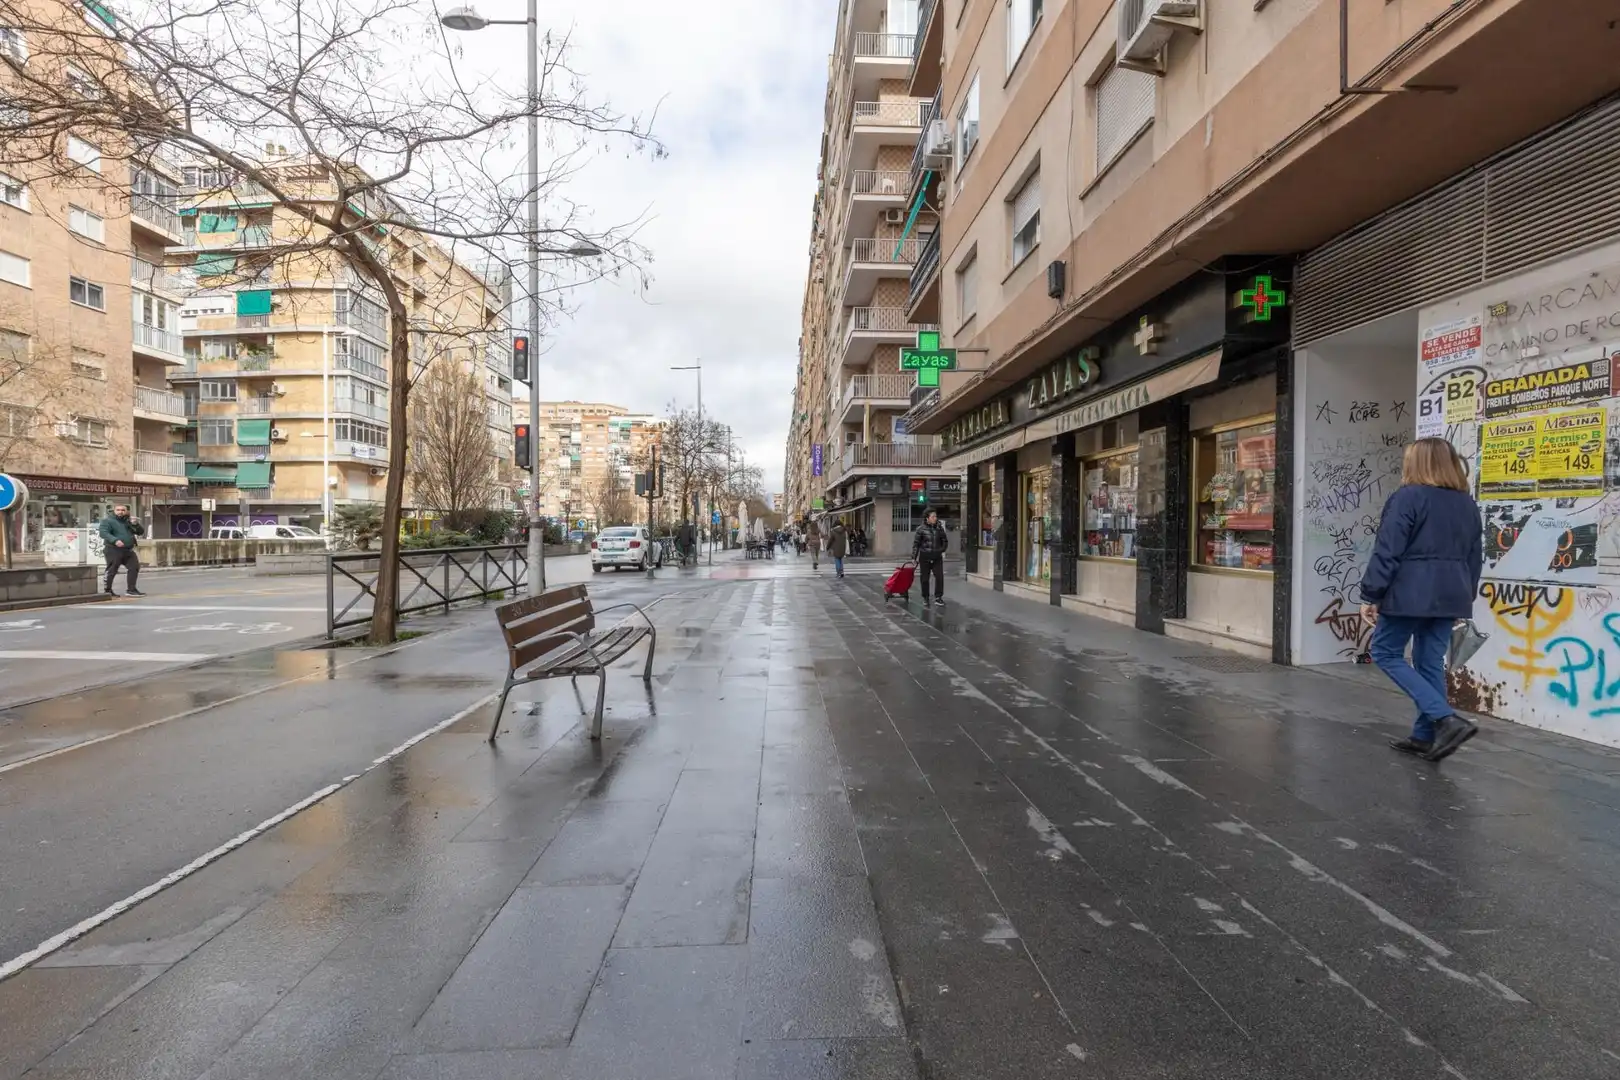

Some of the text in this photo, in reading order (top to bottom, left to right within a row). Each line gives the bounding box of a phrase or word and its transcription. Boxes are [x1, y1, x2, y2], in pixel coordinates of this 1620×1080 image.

[1427, 328, 1477, 348] SE VENDE
[1486, 328, 1558, 357] CAMINO
[1565, 320, 1589, 338] DE
[903, 352, 949, 367] Zayas
[1028, 346, 1096, 410] ZAYAS
[1487, 364, 1590, 397] GRANADA
[1448, 379, 1474, 402] B2
[1486, 396, 1510, 409] FRENTE
[1551, 382, 1581, 398] PARQUE
[1582, 377, 1609, 392] NORTE
[1420, 396, 1442, 417] B1
[1485, 440, 1524, 450] Permiso
[1542, 430, 1601, 445] Permiso B
[24, 479, 63, 491] PRODUCTOS
[63, 481, 72, 489] DE
[110, 484, 114, 492] Y
